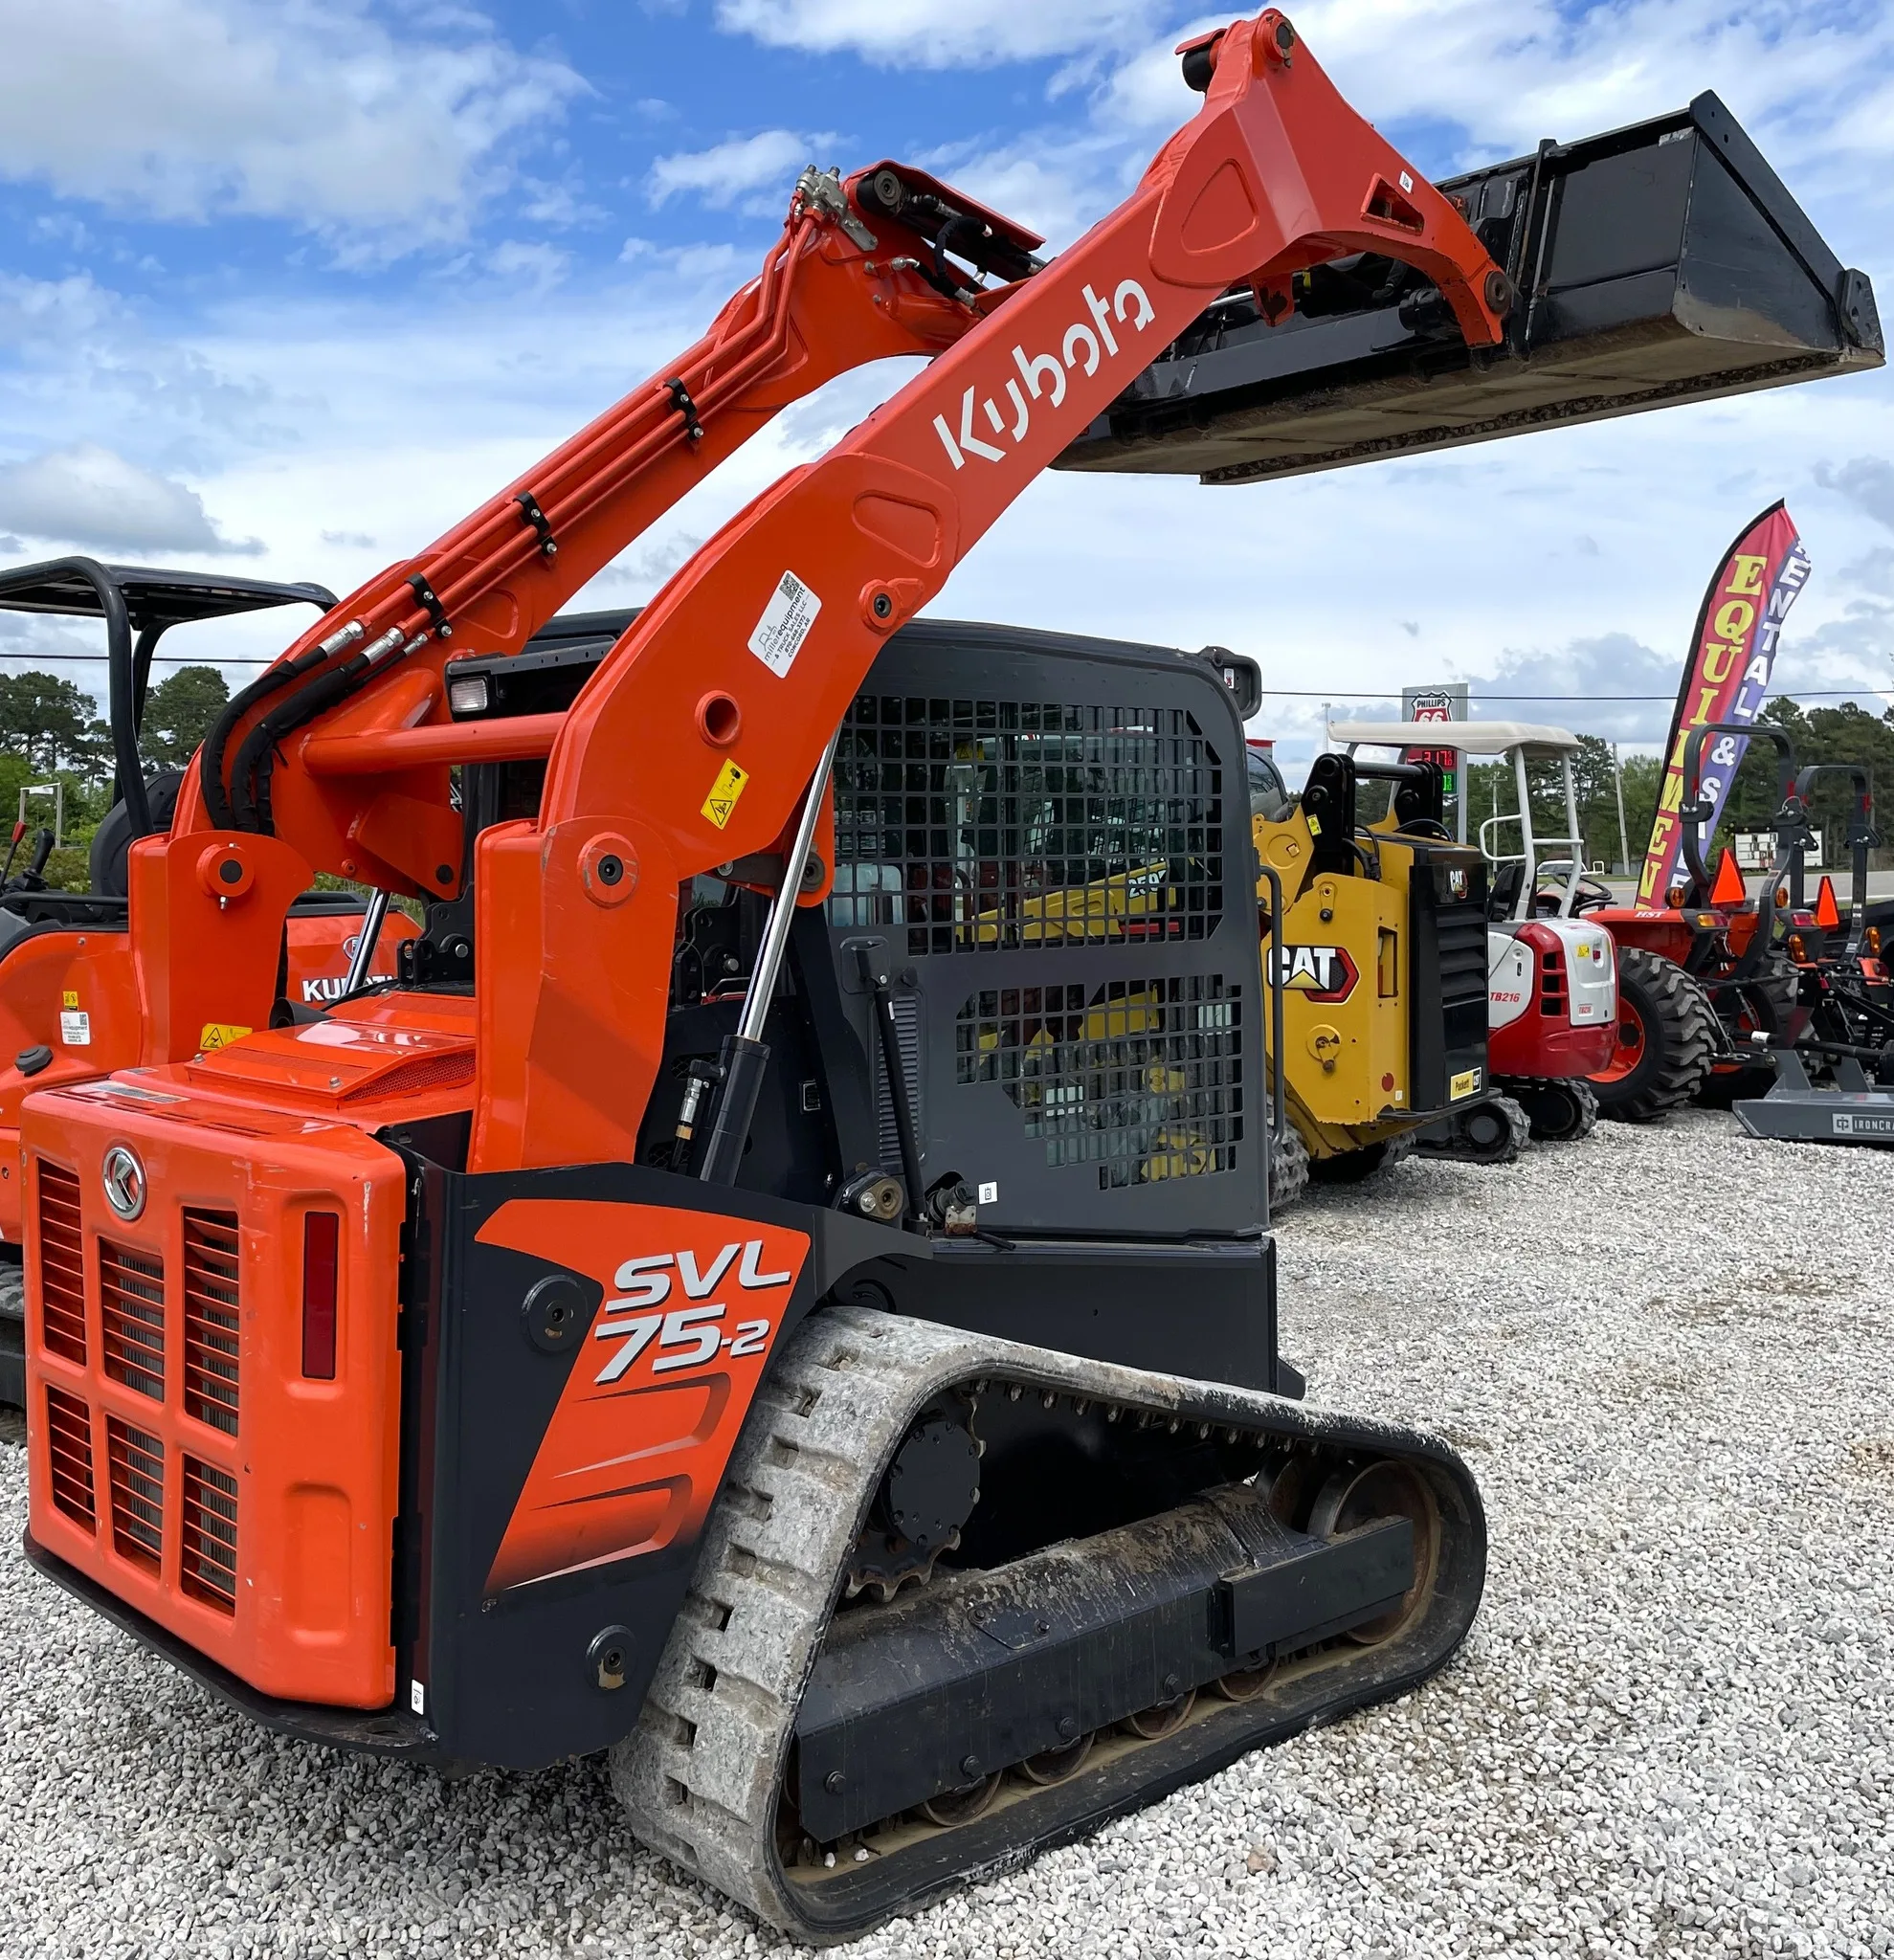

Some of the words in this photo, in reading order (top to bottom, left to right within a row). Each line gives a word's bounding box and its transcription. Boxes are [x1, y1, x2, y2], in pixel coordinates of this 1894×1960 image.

[932, 278, 1156, 470] Kubota
[776, 632, 791, 654] TRUCK
[788, 612, 801, 634] SALES
[798, 599, 808, 613] LLC
[1416, 699, 1446, 708] PHILLIPS
[1711, 736, 1735, 766] &
[1450, 870, 1464, 892] CAT
[1268, 947, 1336, 990] CAT
[1490, 991, 1521, 1003] TB216
[605, 1240, 791, 1315] SVL
[593, 1303, 770, 1385] 75-2
